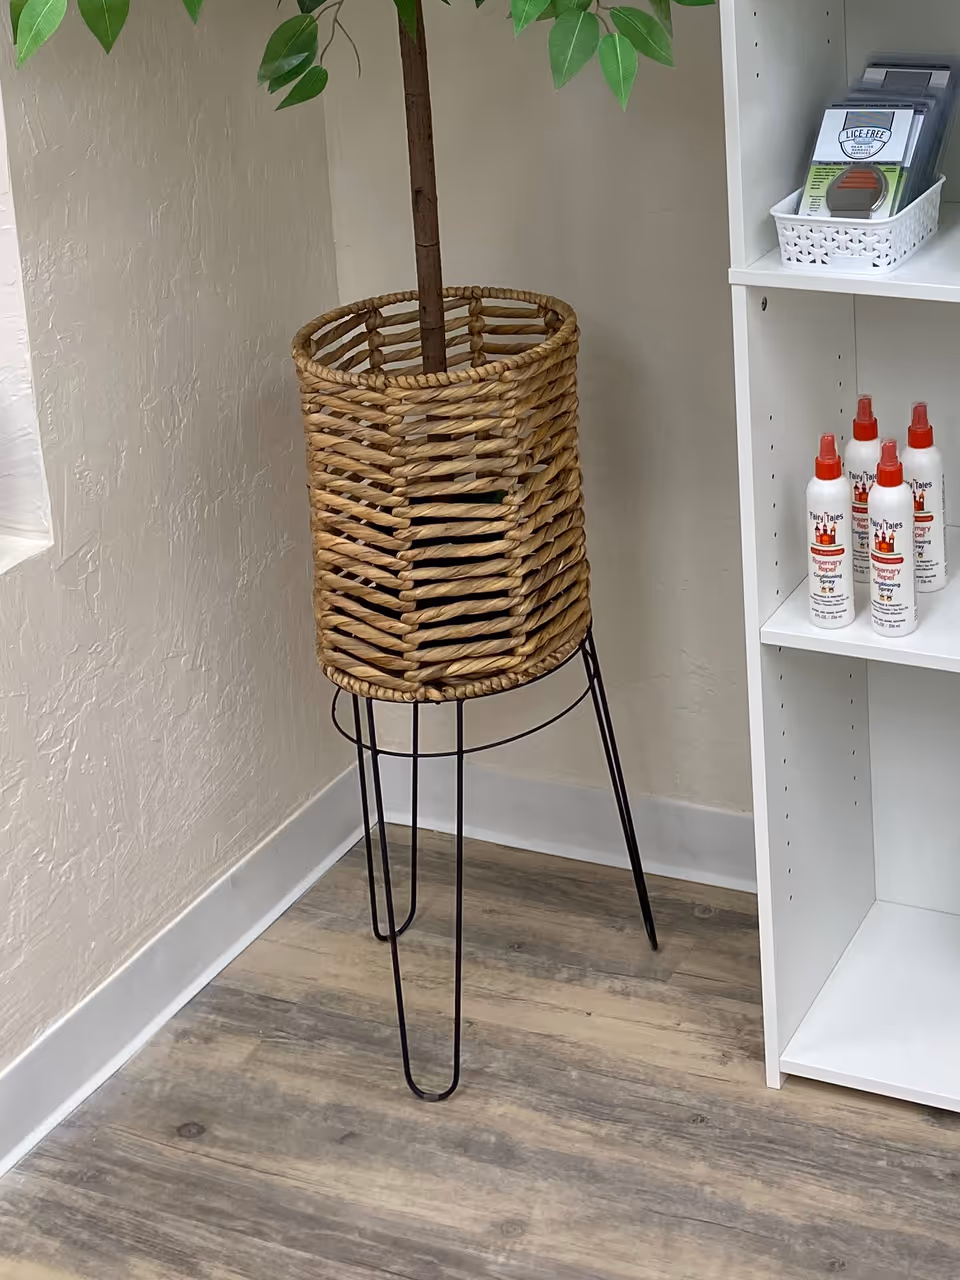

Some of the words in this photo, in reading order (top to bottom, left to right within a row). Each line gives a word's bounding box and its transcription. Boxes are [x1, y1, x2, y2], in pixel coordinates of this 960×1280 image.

[846, 129, 886, 139] LICE-FREE
[849, 471, 862, 481] Fairy
[865, 473, 877, 481] Tale
[809, 511, 823, 523] Fairy
[826, 513, 843, 522] Tales
[886, 522, 903, 530] Tales
[813, 556, 842, 566] Rosemary
[872, 563, 901, 575] Rosemary
[879, 585, 893, 594] Spray
